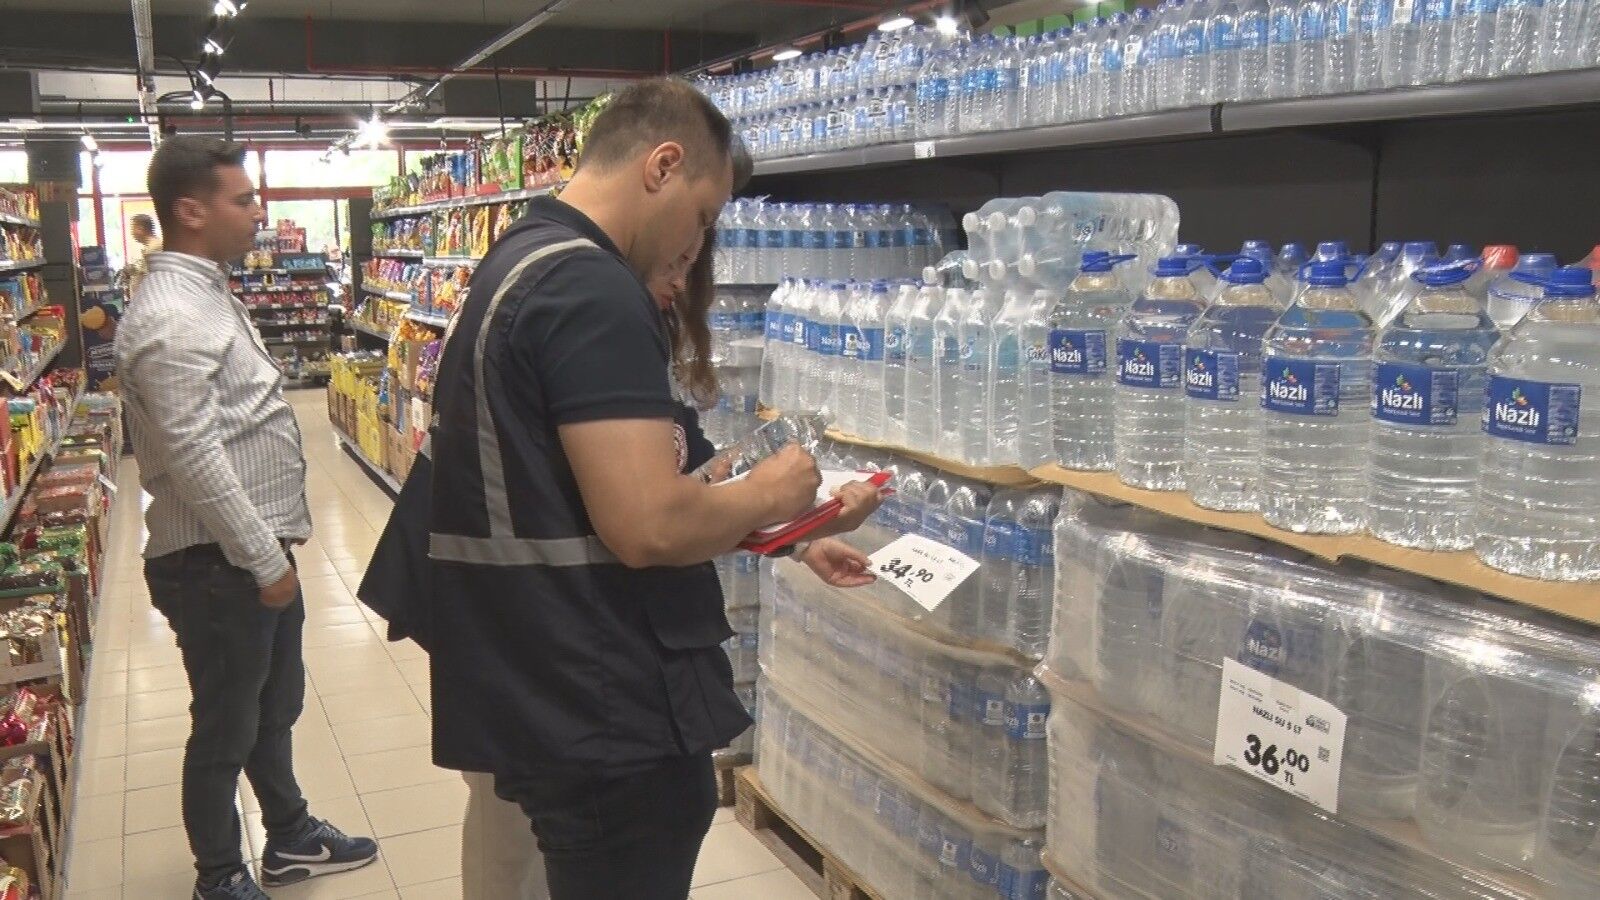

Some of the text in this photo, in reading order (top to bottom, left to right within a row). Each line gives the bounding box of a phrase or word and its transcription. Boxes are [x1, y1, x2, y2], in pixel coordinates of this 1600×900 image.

[1270, 381, 1307, 401] Nazlı
[1382, 389, 1424, 409] Nazlı
[1495, 402, 1540, 426] Nazlı
[1244, 733, 1310, 776] 36,00
